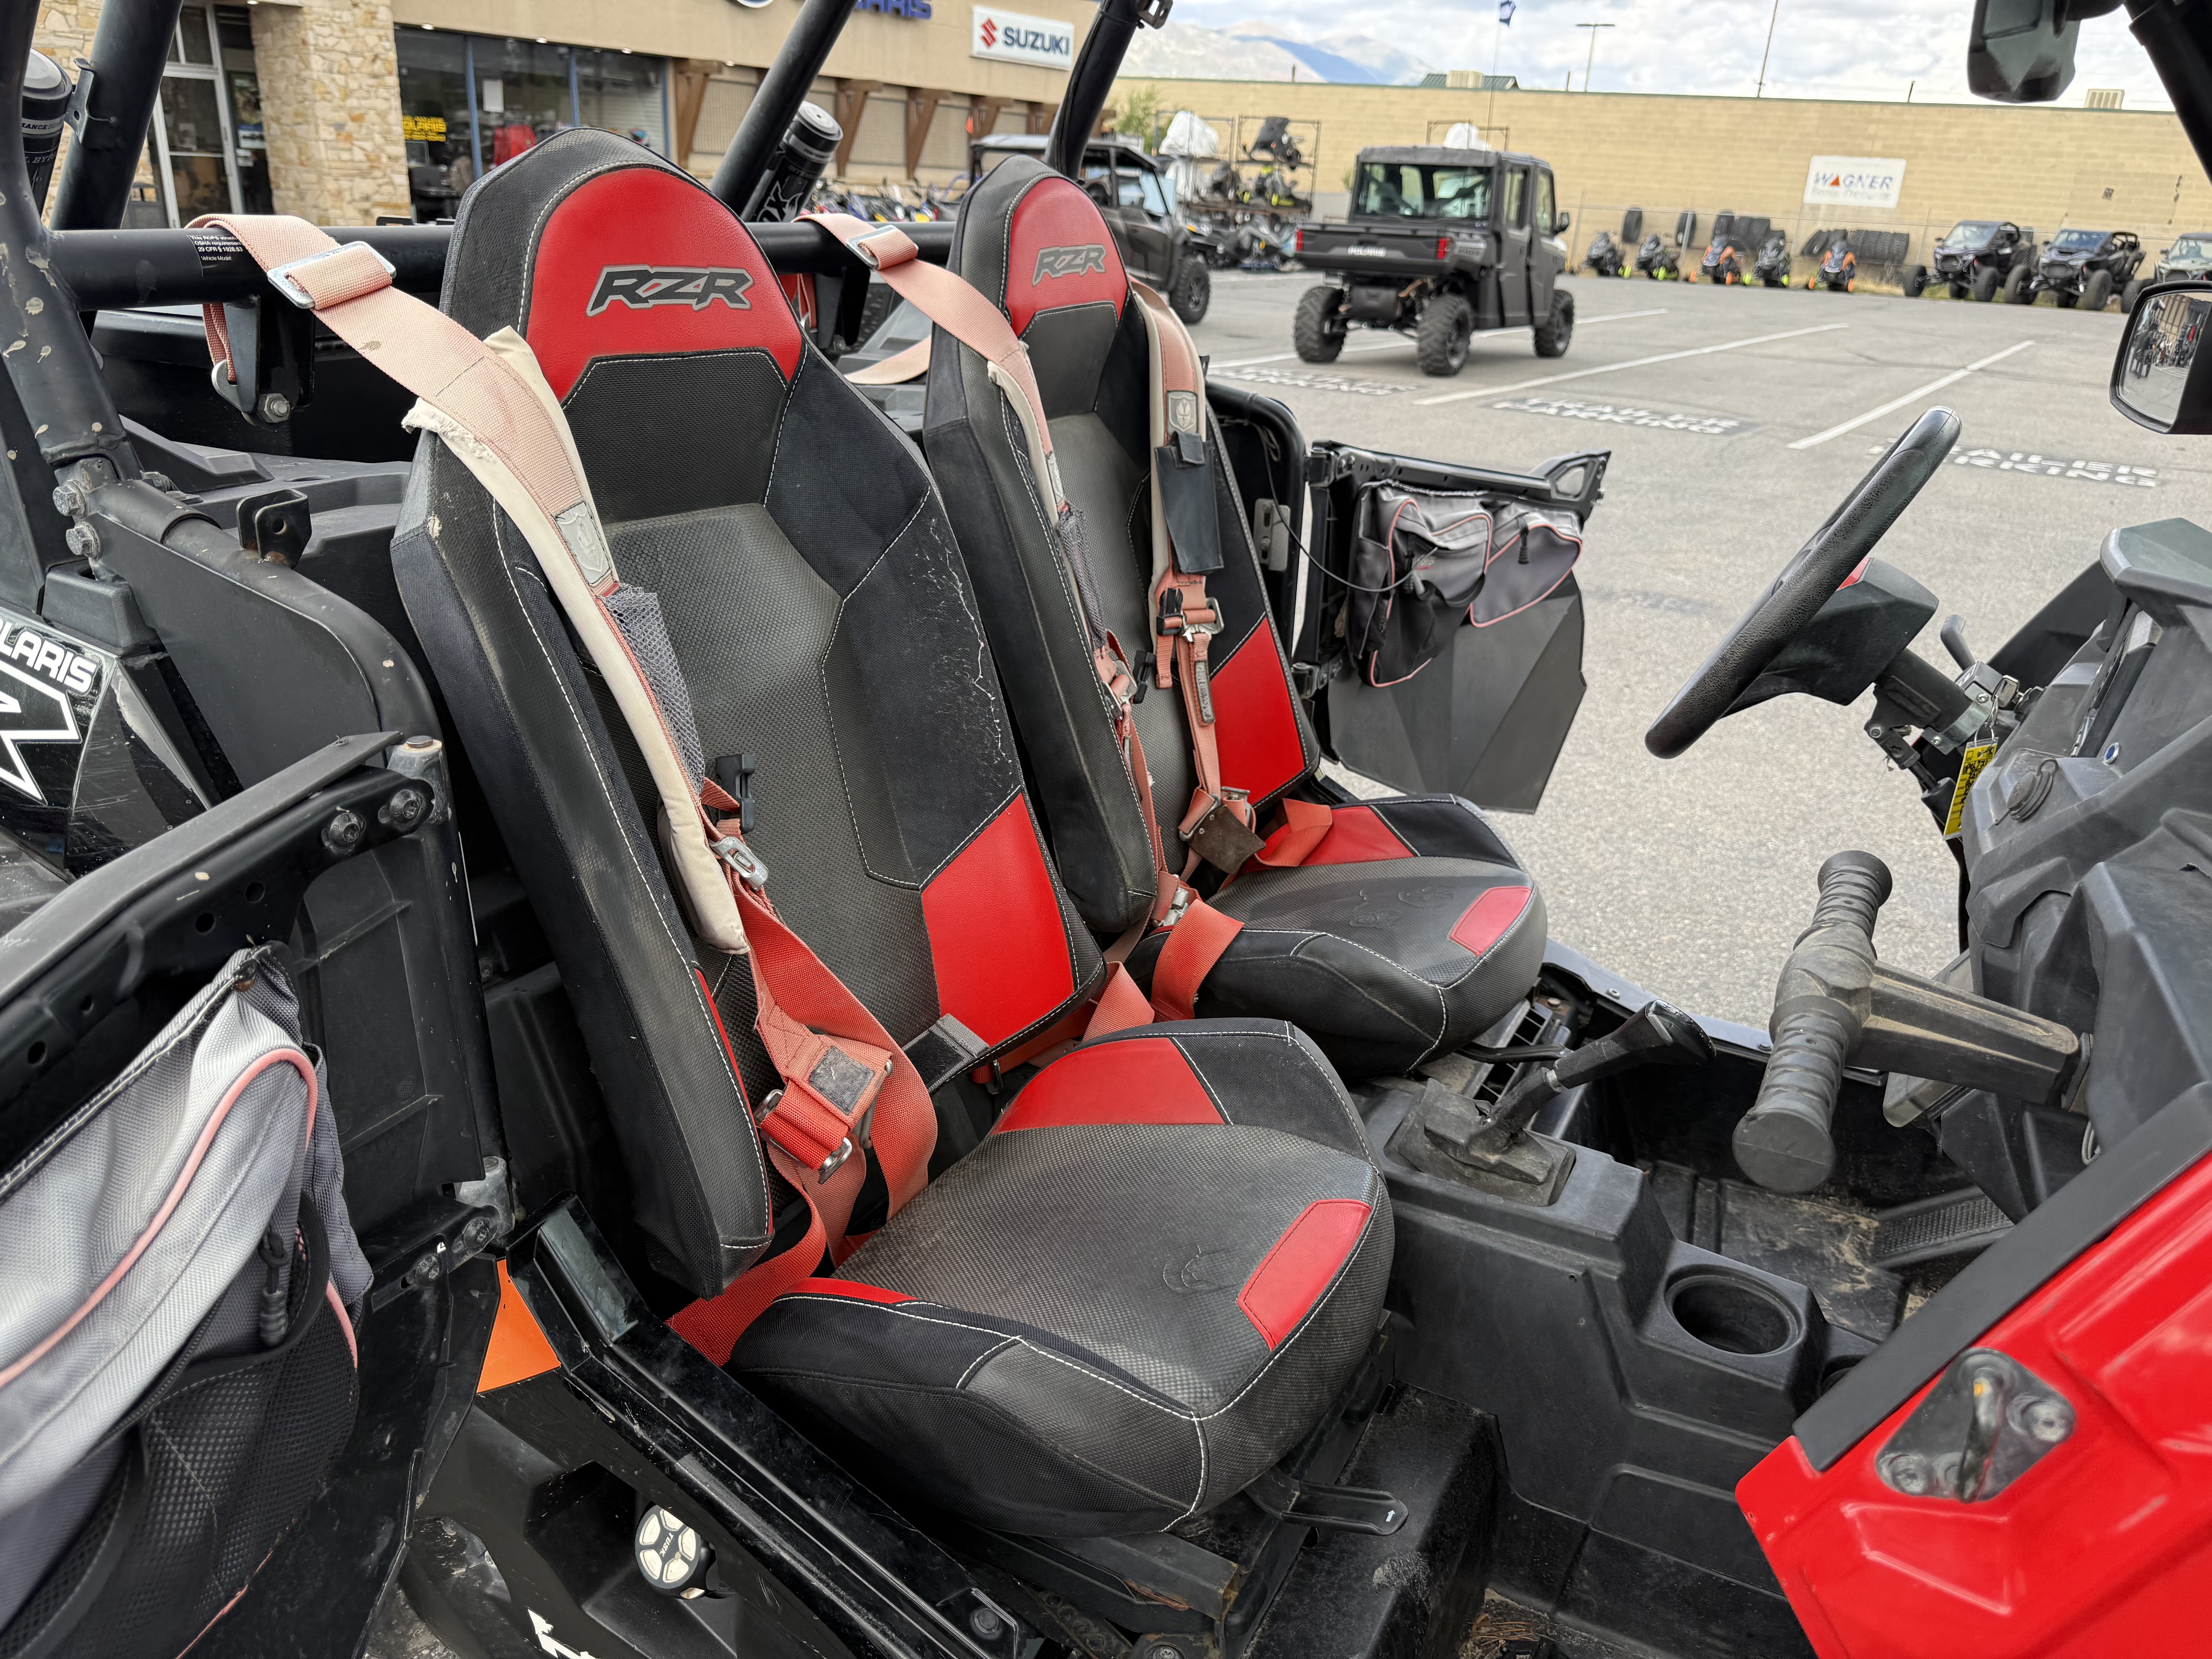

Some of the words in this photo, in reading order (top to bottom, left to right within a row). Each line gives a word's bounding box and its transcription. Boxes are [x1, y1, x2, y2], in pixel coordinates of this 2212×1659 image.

[1003, 26, 1070, 55] SUZUKI
[403, 120, 447, 132] OLARIS
[1814, 173, 1893, 190] WAGNER
[1032, 244, 1106, 287] RZR
[586, 264, 755, 318] RZR
[0, 618, 97, 692] LARIS
[659, 1532, 674, 1557] TUSK
